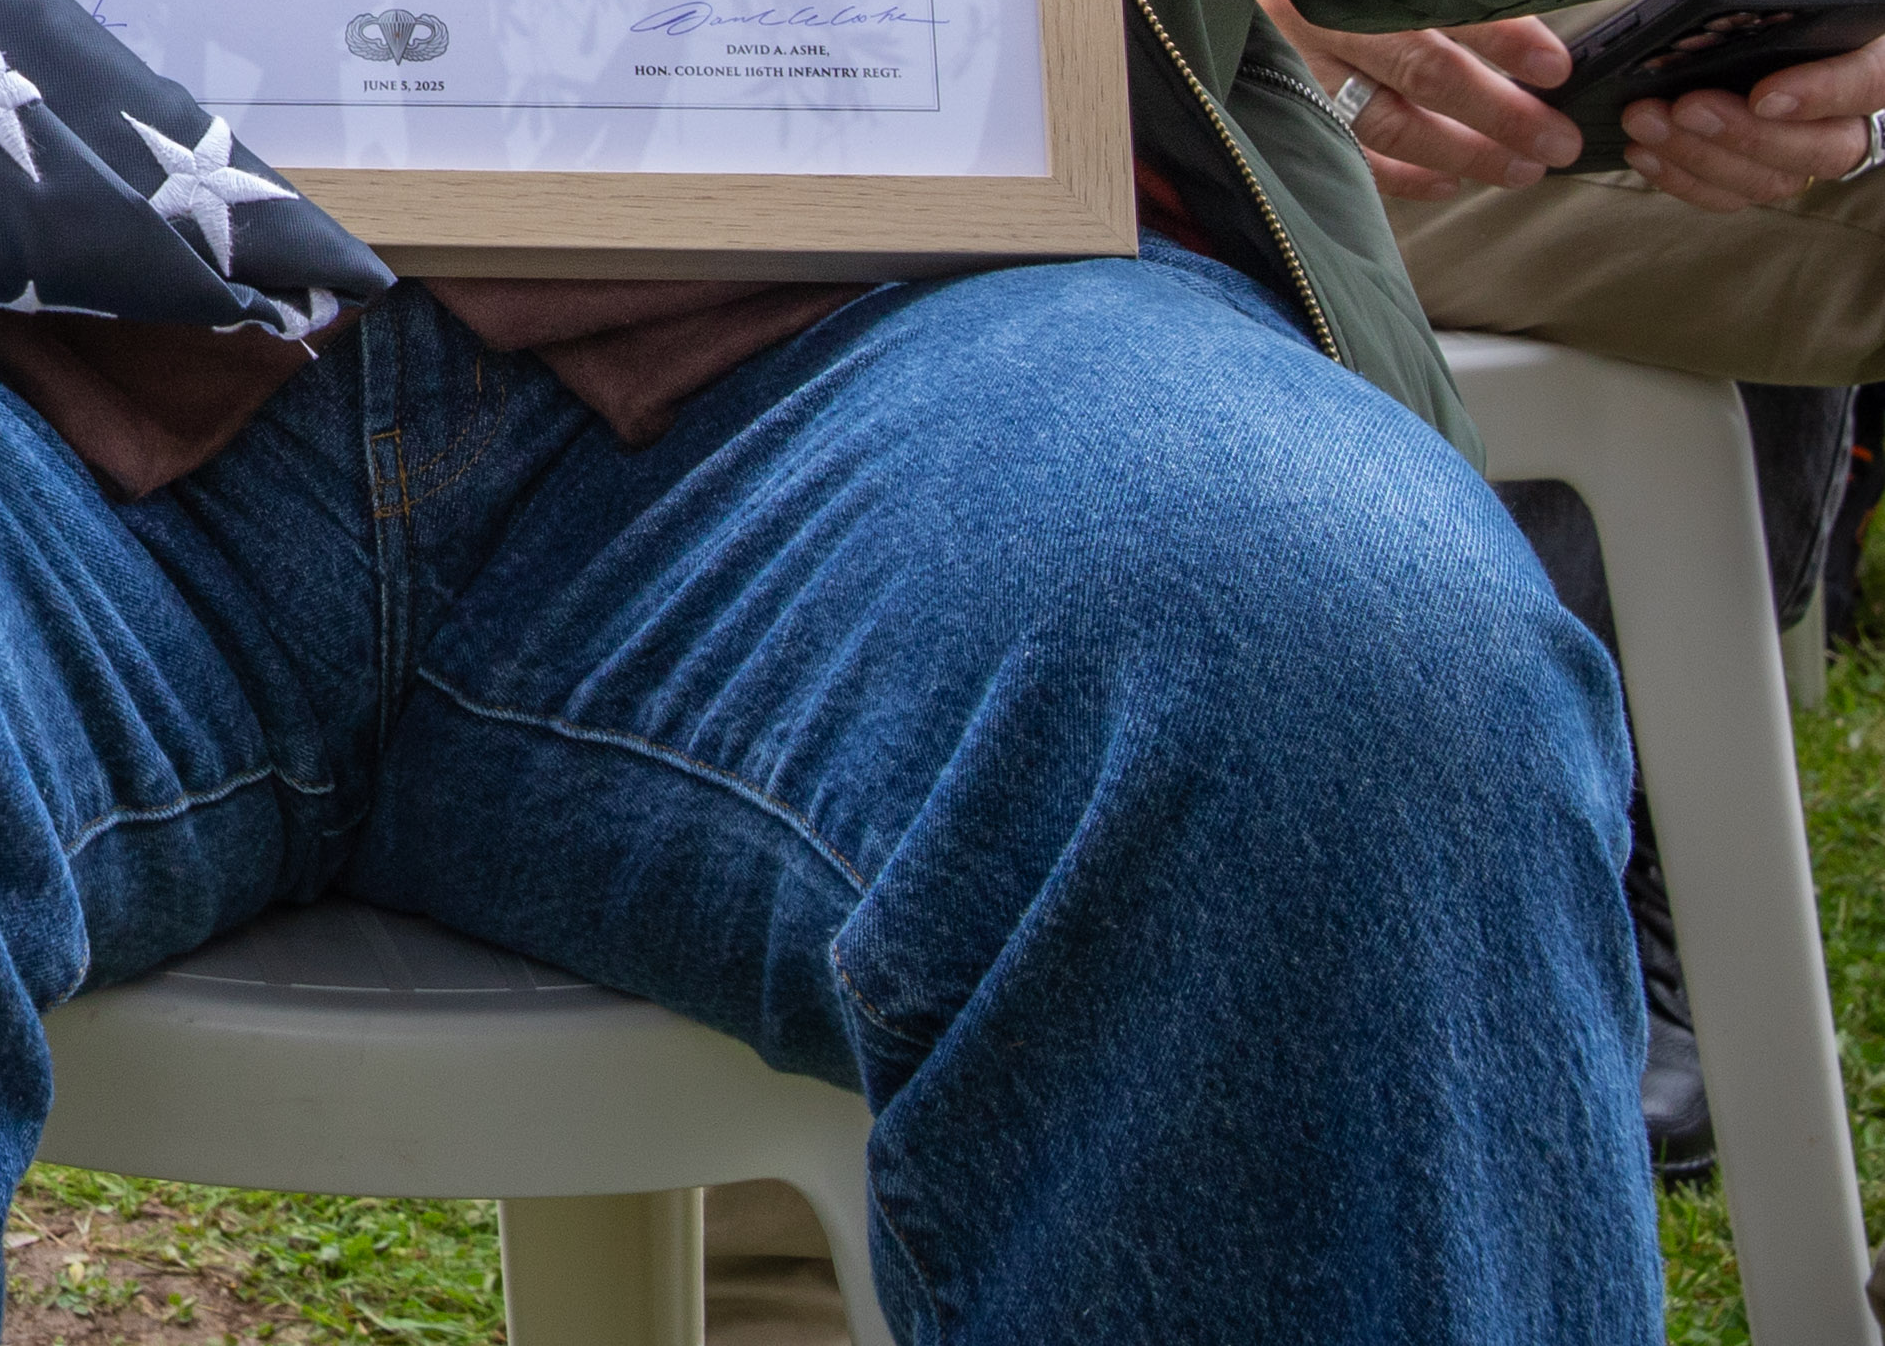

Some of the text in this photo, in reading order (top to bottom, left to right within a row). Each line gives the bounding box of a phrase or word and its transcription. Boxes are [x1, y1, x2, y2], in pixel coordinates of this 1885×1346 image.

[726, 44, 830, 57] DAVID A. ASHE,
[634, 65, 902, 79] HON. COLONEL 116TH INFANTRY REGT.
[363, 80, 445, 92] JUNE 5, 2025
